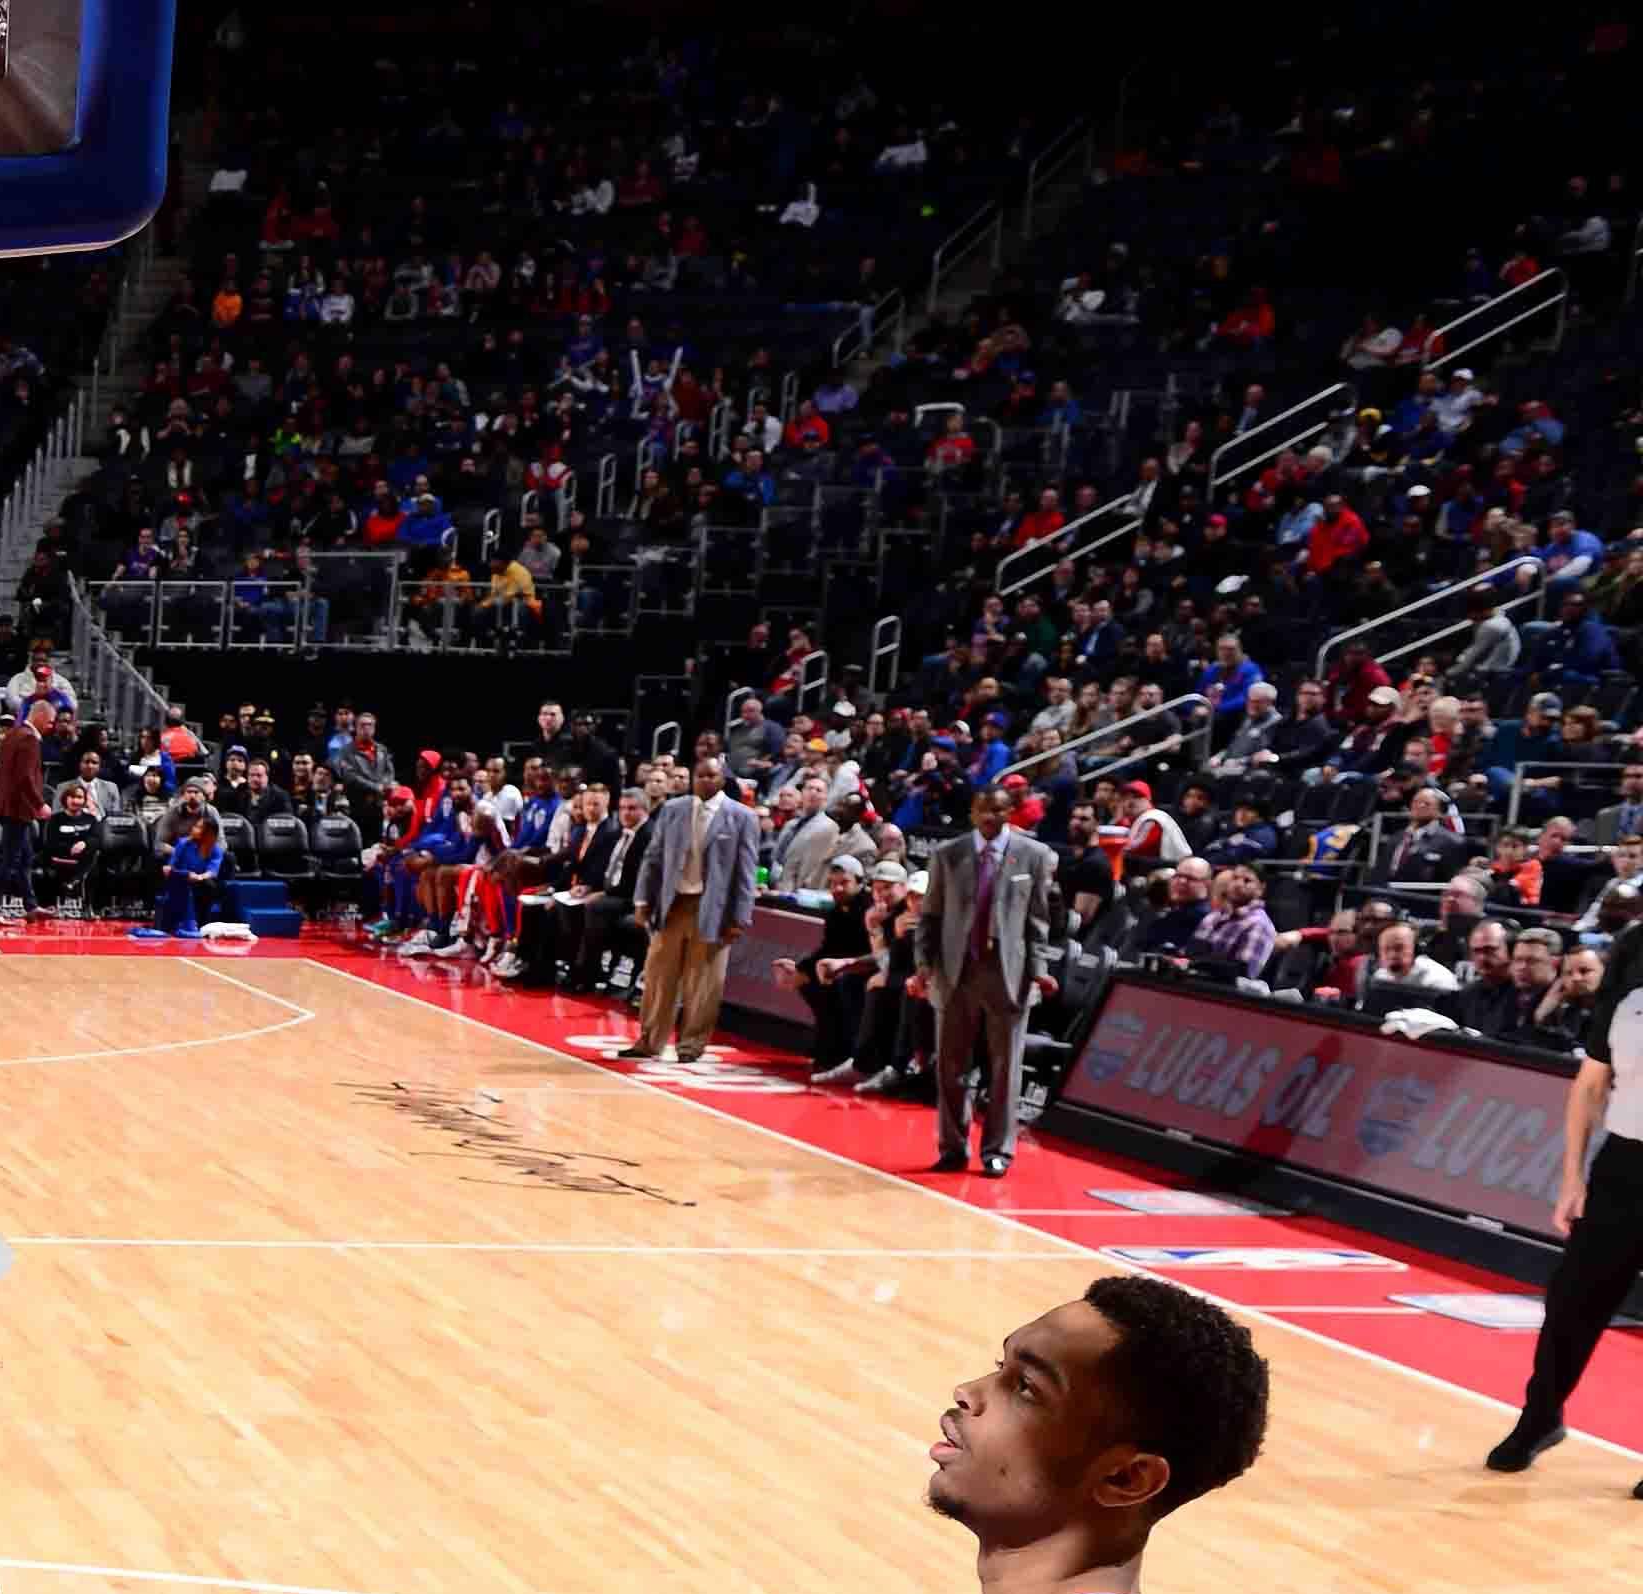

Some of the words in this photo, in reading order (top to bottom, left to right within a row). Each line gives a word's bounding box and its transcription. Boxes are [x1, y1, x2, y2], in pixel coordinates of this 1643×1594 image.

[1128, 1023, 1280, 1120] LUCAS
[1263, 1053, 1358, 1139] OIL
[1412, 1092, 1567, 1216] LUCA
